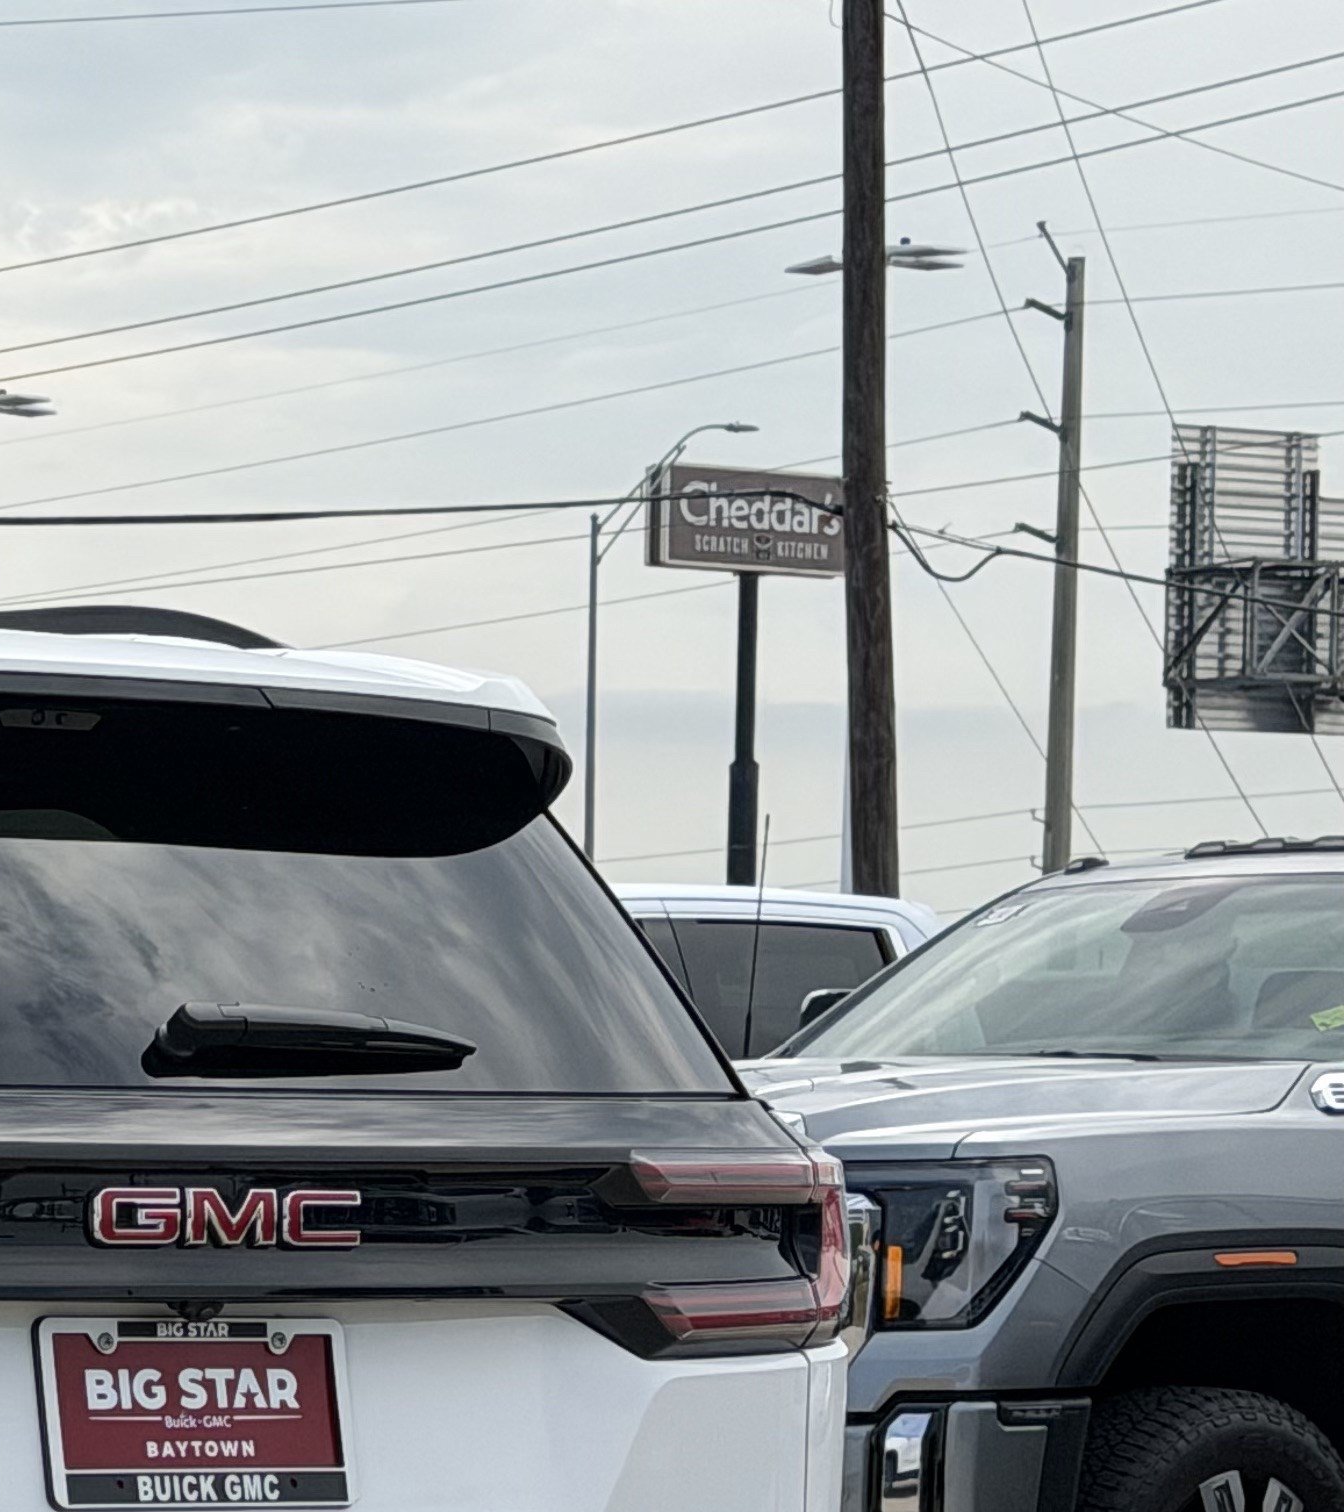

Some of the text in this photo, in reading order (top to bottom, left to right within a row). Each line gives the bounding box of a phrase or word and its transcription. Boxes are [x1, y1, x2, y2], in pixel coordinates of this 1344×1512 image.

[678, 480, 841, 535] Cheddar's
[694, 535, 829, 560] SCRATCH KITCHEN
[93, 1186, 362, 1247] GMC
[156, 1322, 230, 1338] BIG STAR
[84, 1367, 300, 1411] BIG STAR
[145, 1439, 256, 1458] BAYTOWN
[137, 1474, 280, 1502] BUICK GMC
